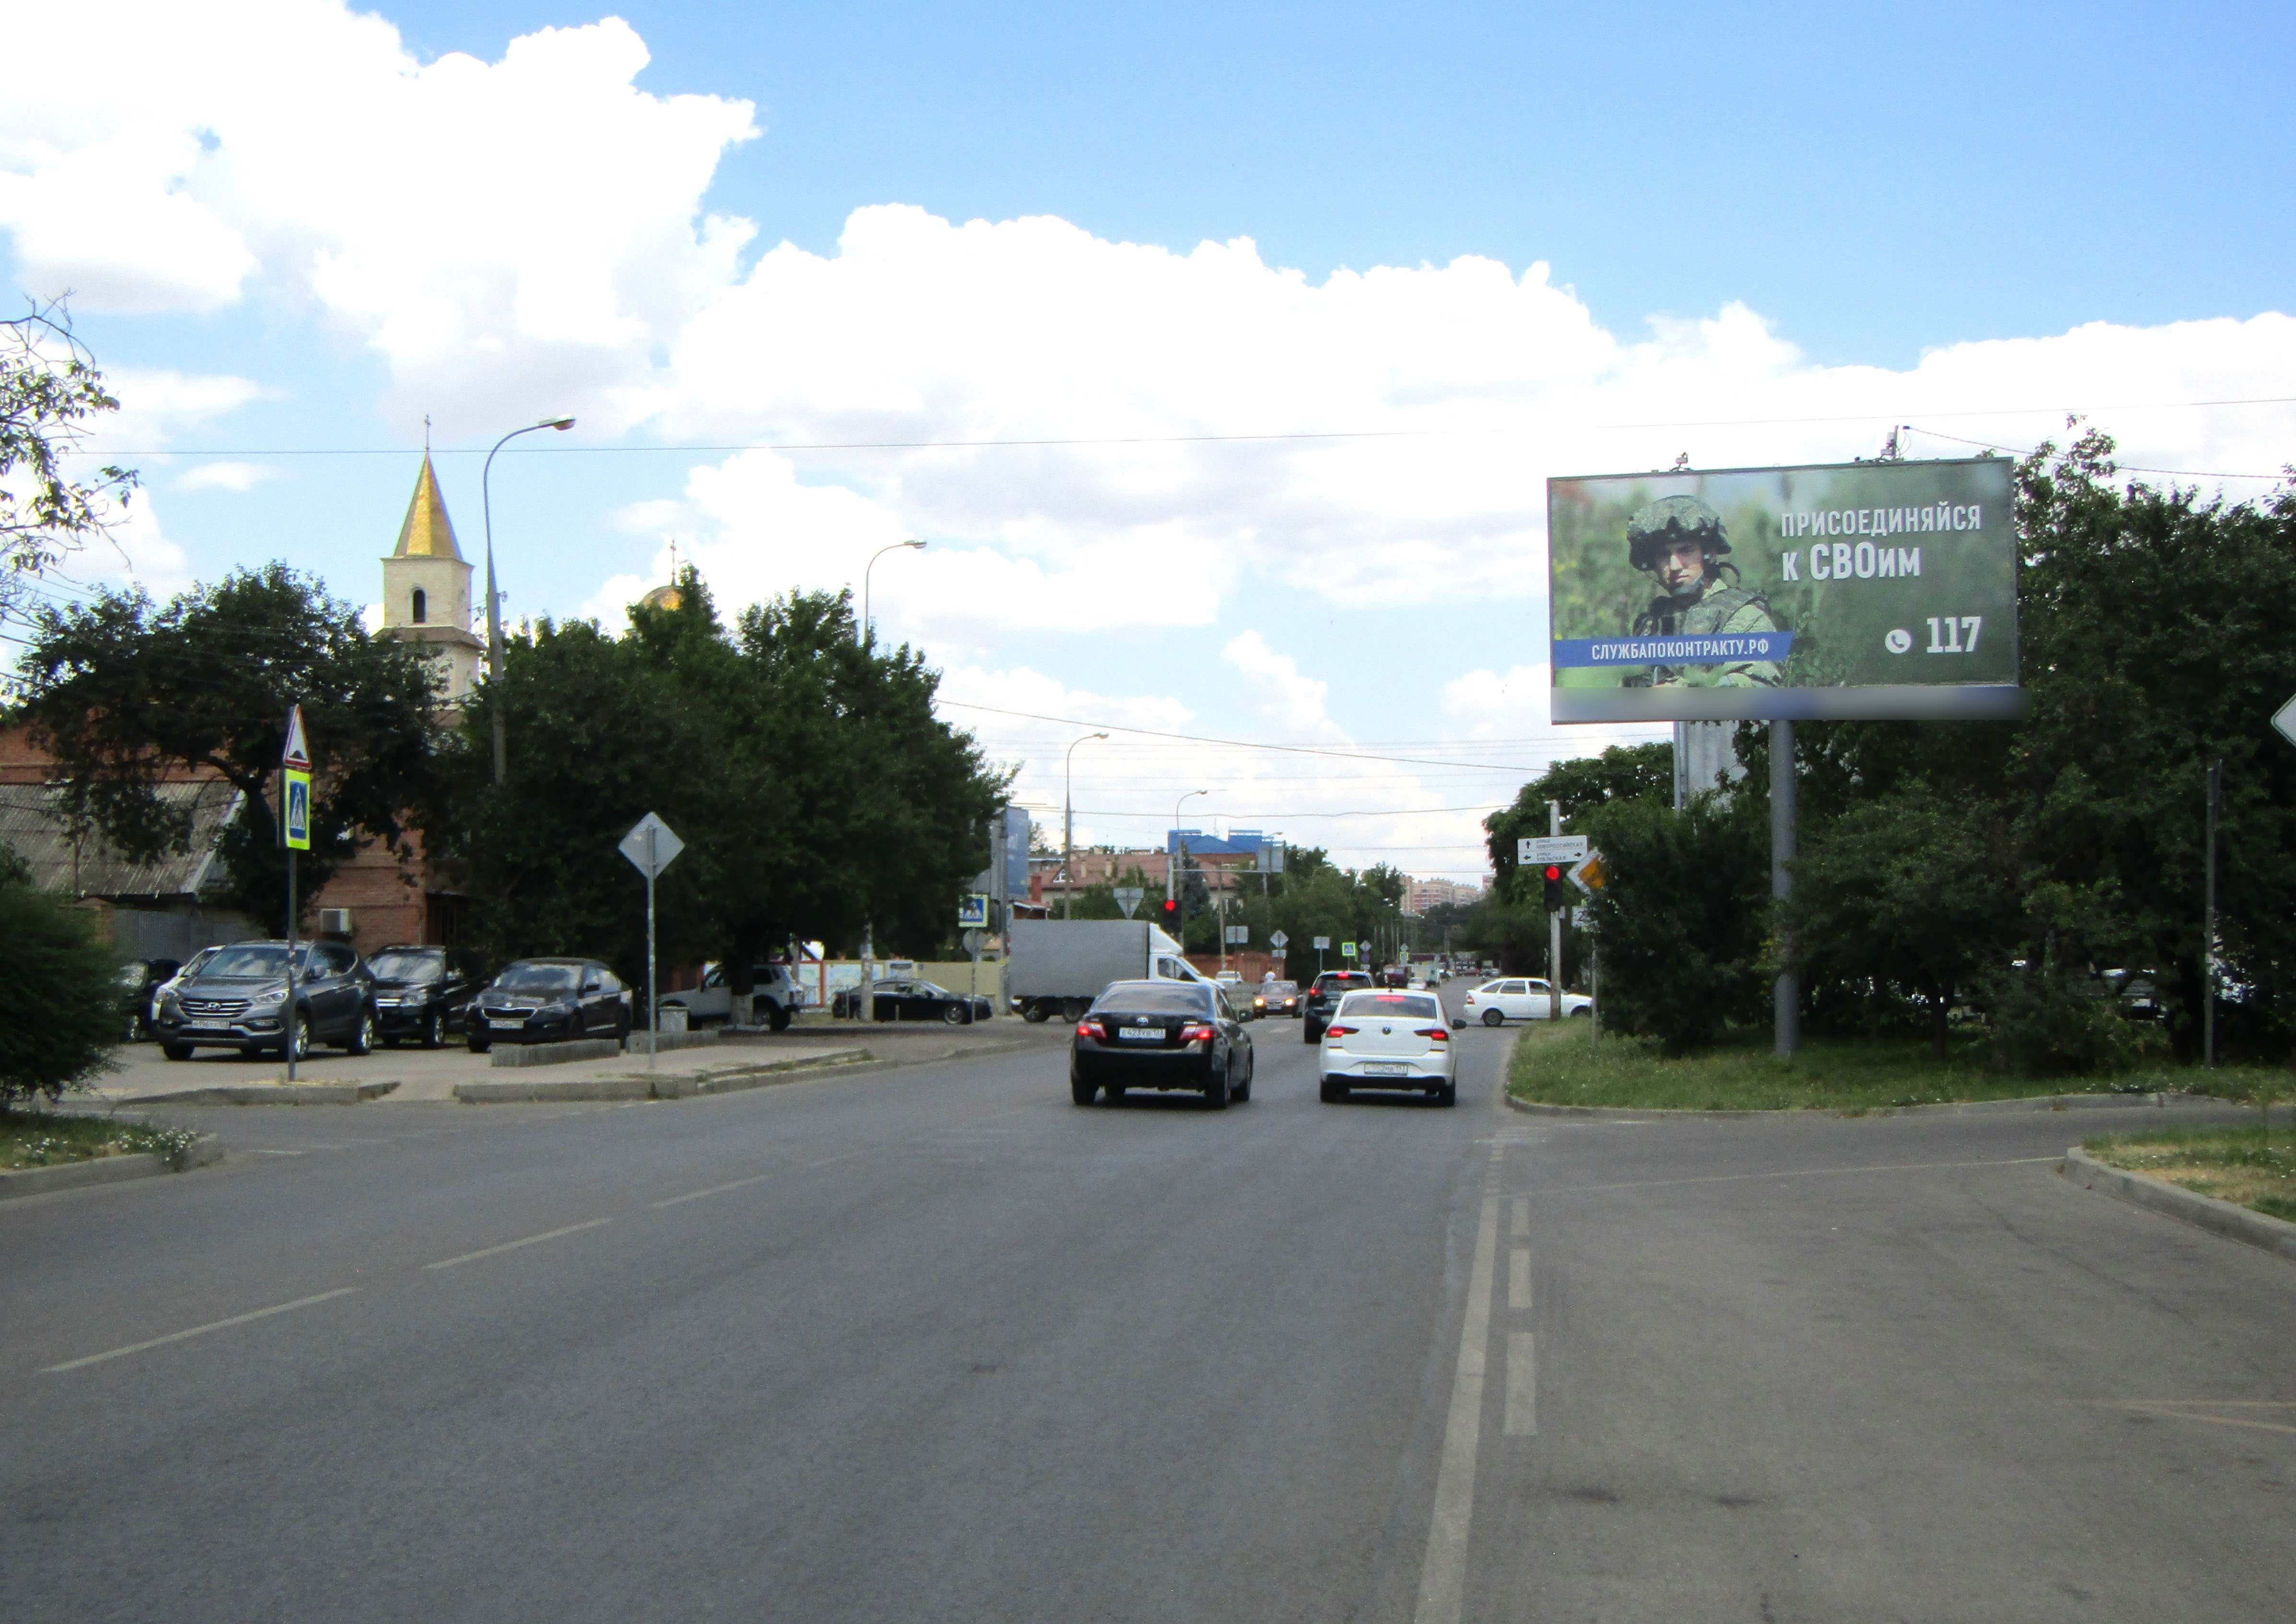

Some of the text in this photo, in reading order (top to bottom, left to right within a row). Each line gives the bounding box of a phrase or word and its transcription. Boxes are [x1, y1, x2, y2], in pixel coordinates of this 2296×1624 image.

[1781, 501, 1981, 537] ПРИСОЕДИНЯЙСЯ
[1810, 541, 1920, 580] СВОим
[1591, 638, 1769, 660] СЛУЖБАПОКОНТРАКТУ.РФ
[1926, 616, 1981, 653] 117
